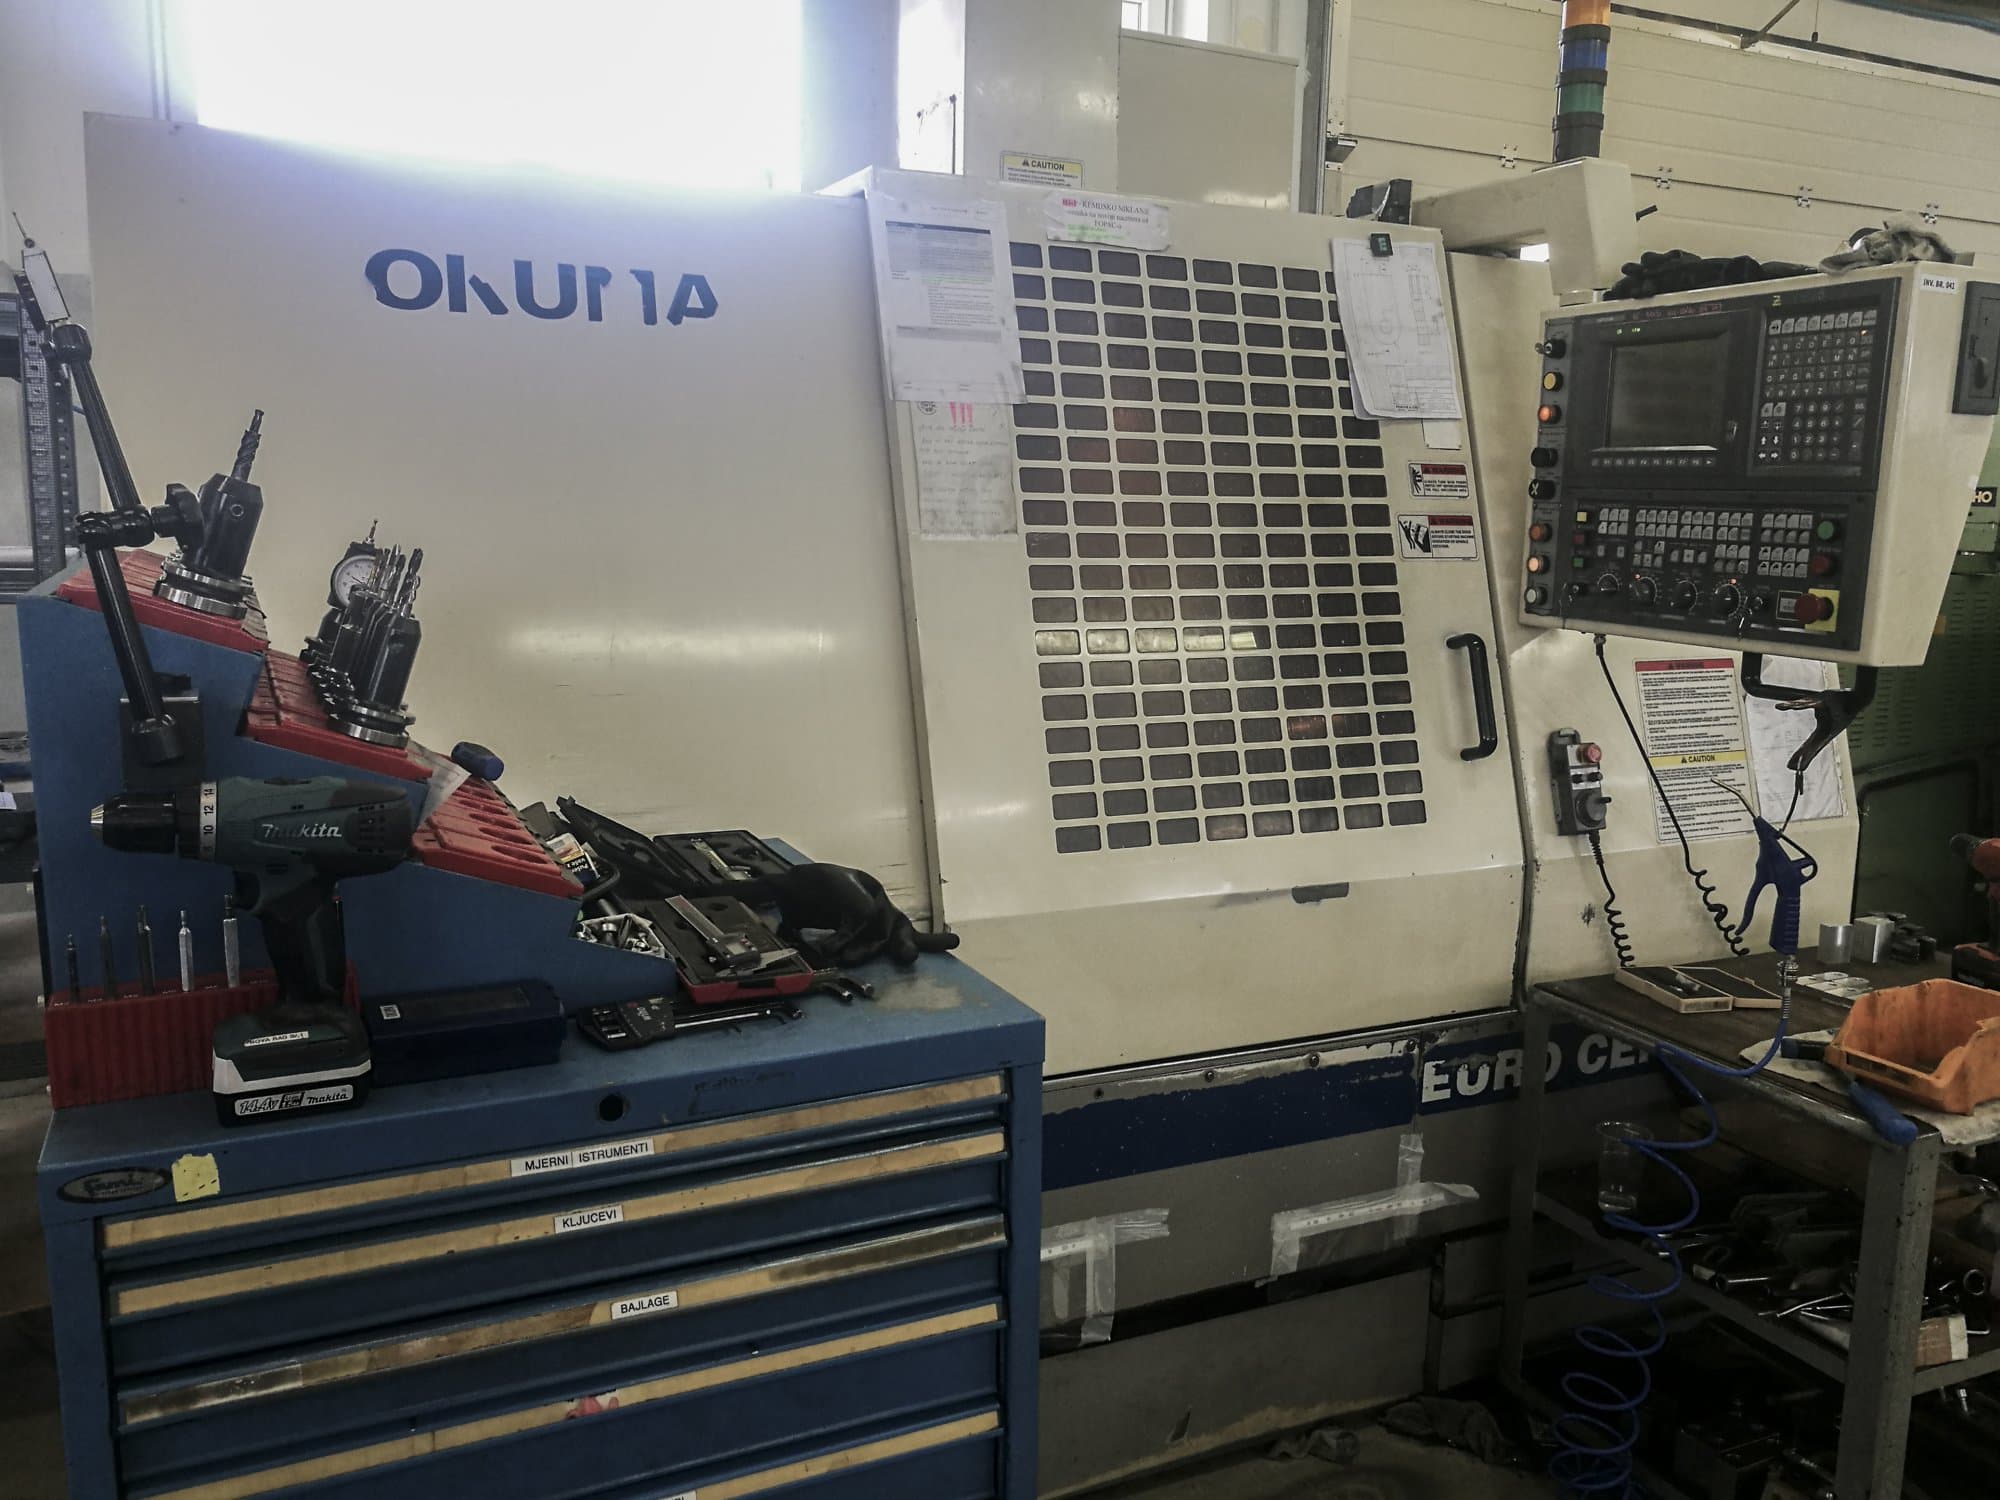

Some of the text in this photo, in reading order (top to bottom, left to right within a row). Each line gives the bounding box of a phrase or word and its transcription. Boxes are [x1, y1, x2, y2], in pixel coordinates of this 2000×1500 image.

[1031, 160, 1065, 172] CAUTION
[1923, 278, 1935, 287] INV.
[1688, 755, 1716, 764] CAUTION
[204, 804, 214, 816] 12
[203, 825, 214, 835] 10
[524, 1142, 649, 1171] MJERNI ISTRUMENTI
[562, 1209, 617, 1229] KLJUCEVI
[620, 1295, 670, 1314] BAJLAGE
